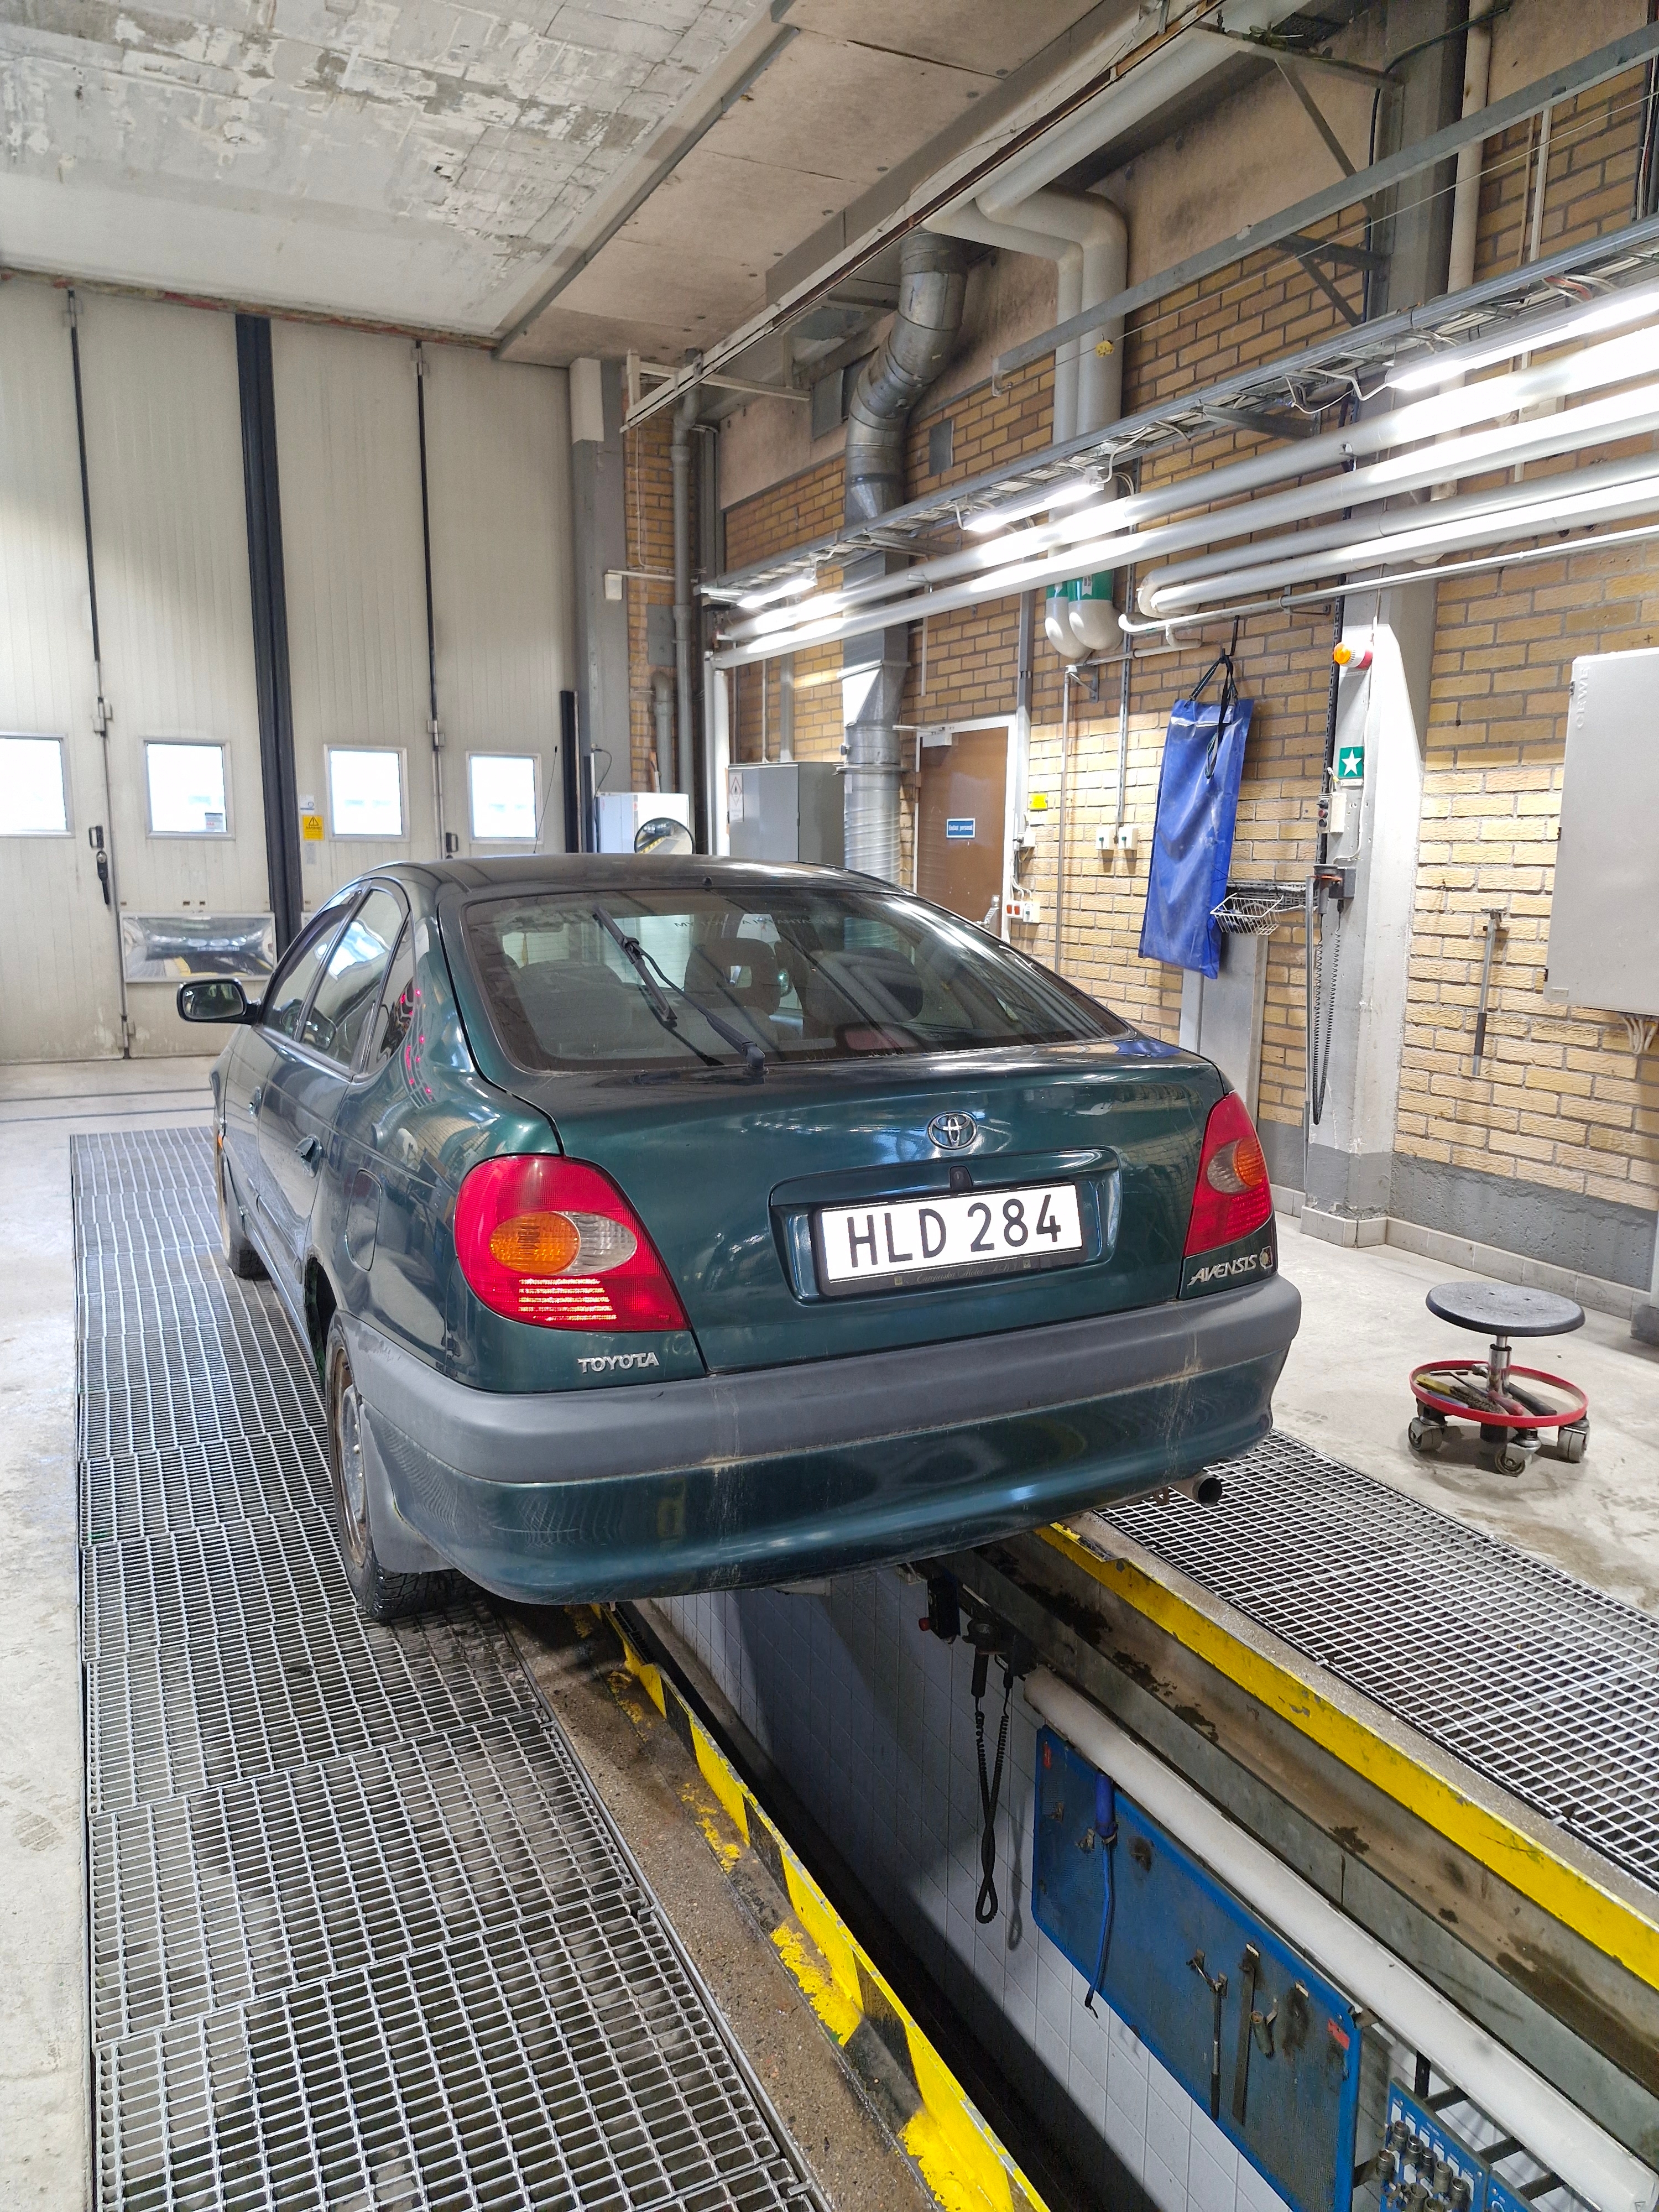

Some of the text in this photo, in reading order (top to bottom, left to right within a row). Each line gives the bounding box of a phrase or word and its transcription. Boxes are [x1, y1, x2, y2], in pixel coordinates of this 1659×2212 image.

[847, 1194, 1062, 1268] HLD 284
[957, 1266, 984, 1279] Motor
[1187, 1254, 1258, 1286] AVENSIS
[577, 1352, 660, 1374] TOYOTA
